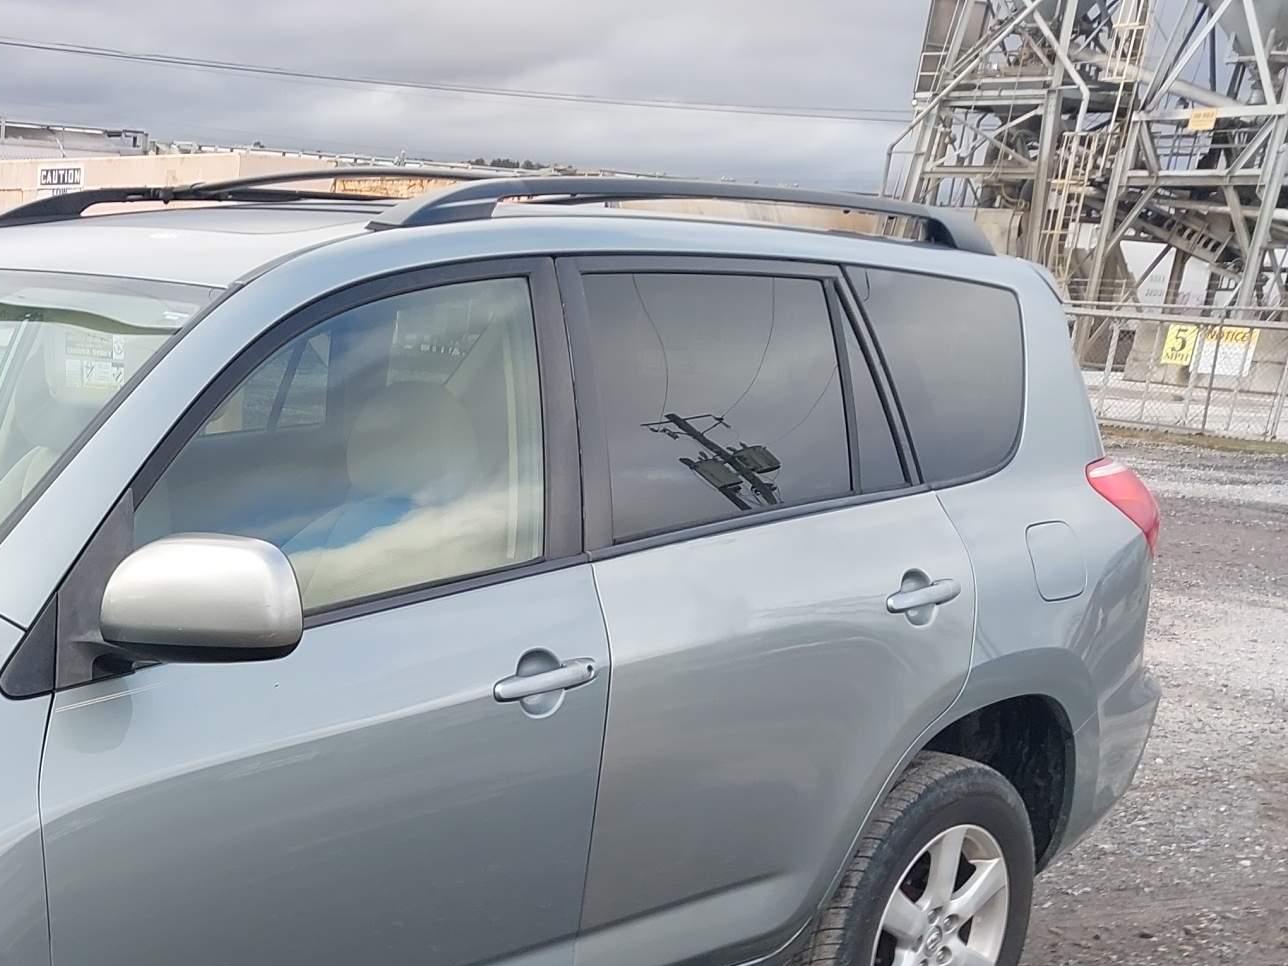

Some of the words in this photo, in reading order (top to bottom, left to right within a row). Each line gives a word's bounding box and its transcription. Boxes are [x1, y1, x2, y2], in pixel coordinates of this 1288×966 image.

[41, 169, 80, 184] CAUTION
[1170, 328, 1188, 352] 5
[1164, 352, 1189, 361] MPH
